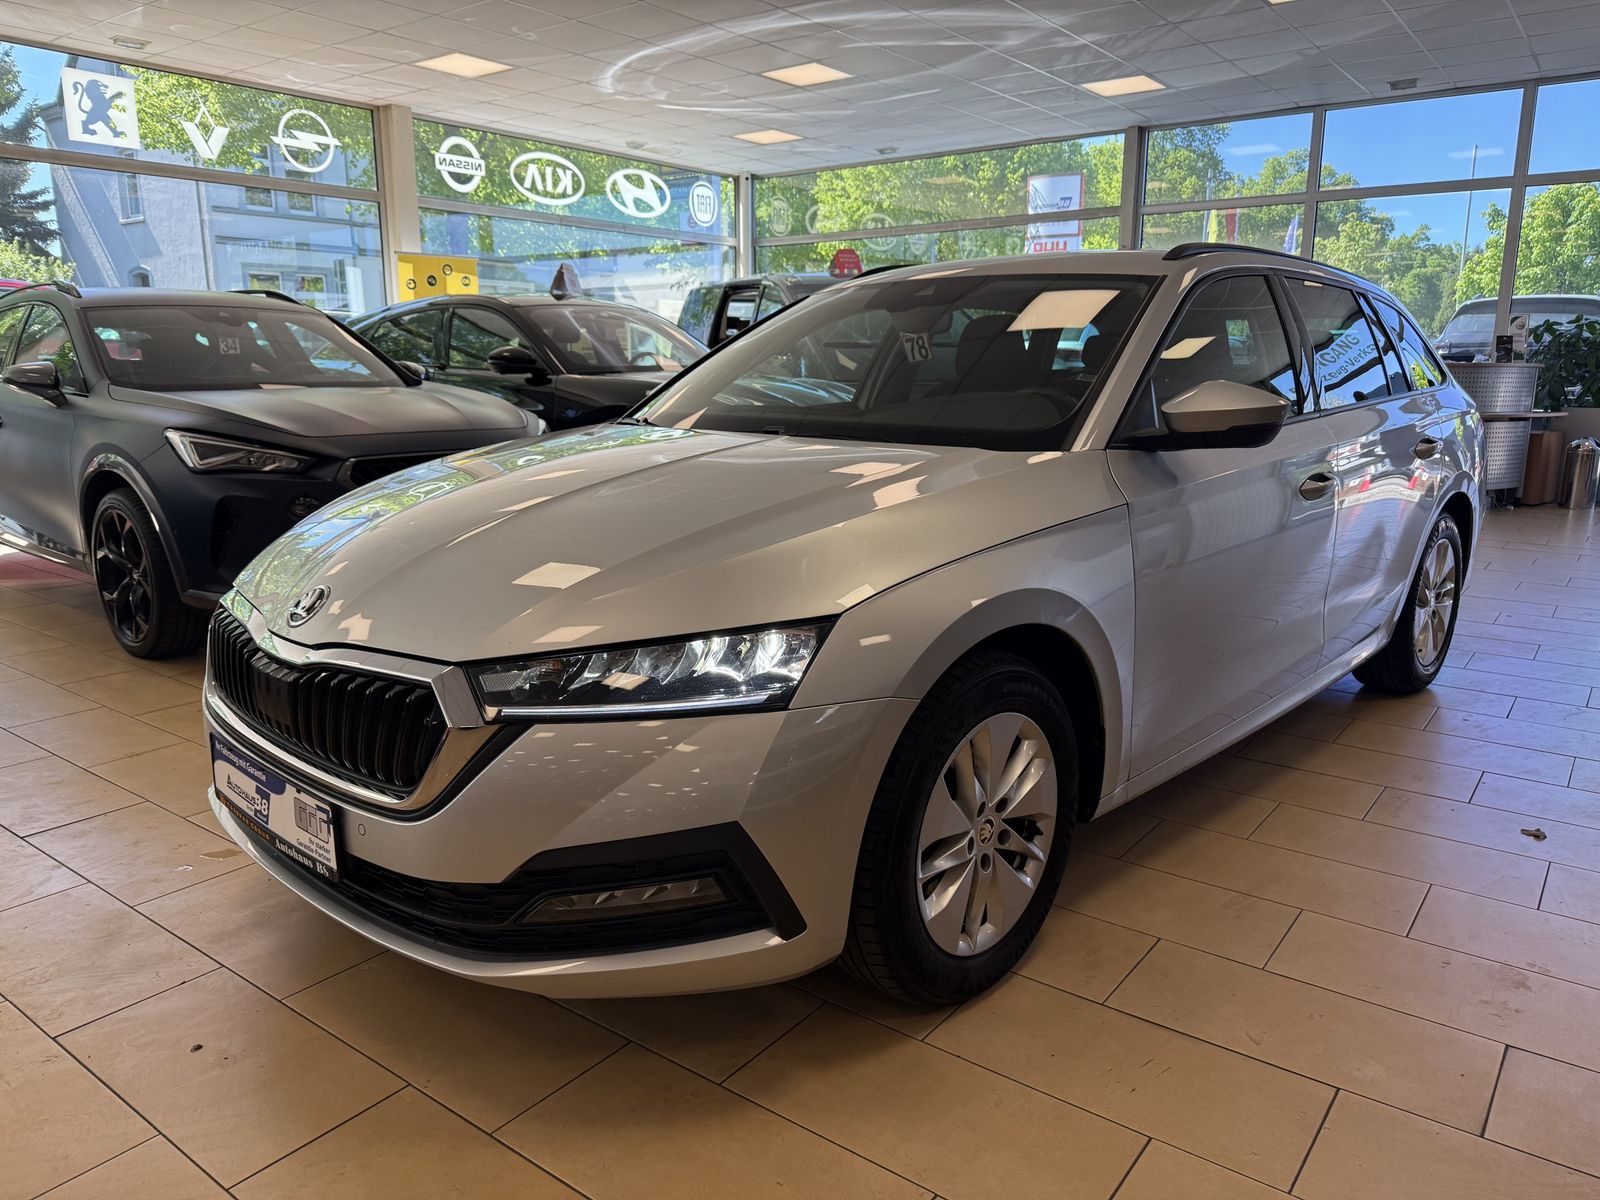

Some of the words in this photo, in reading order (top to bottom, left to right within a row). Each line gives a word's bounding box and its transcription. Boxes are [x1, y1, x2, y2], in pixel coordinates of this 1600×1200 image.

[221, 339, 238, 353] 34
[904, 335, 929, 361] 78
[275, 838, 313, 869] Autohaus
